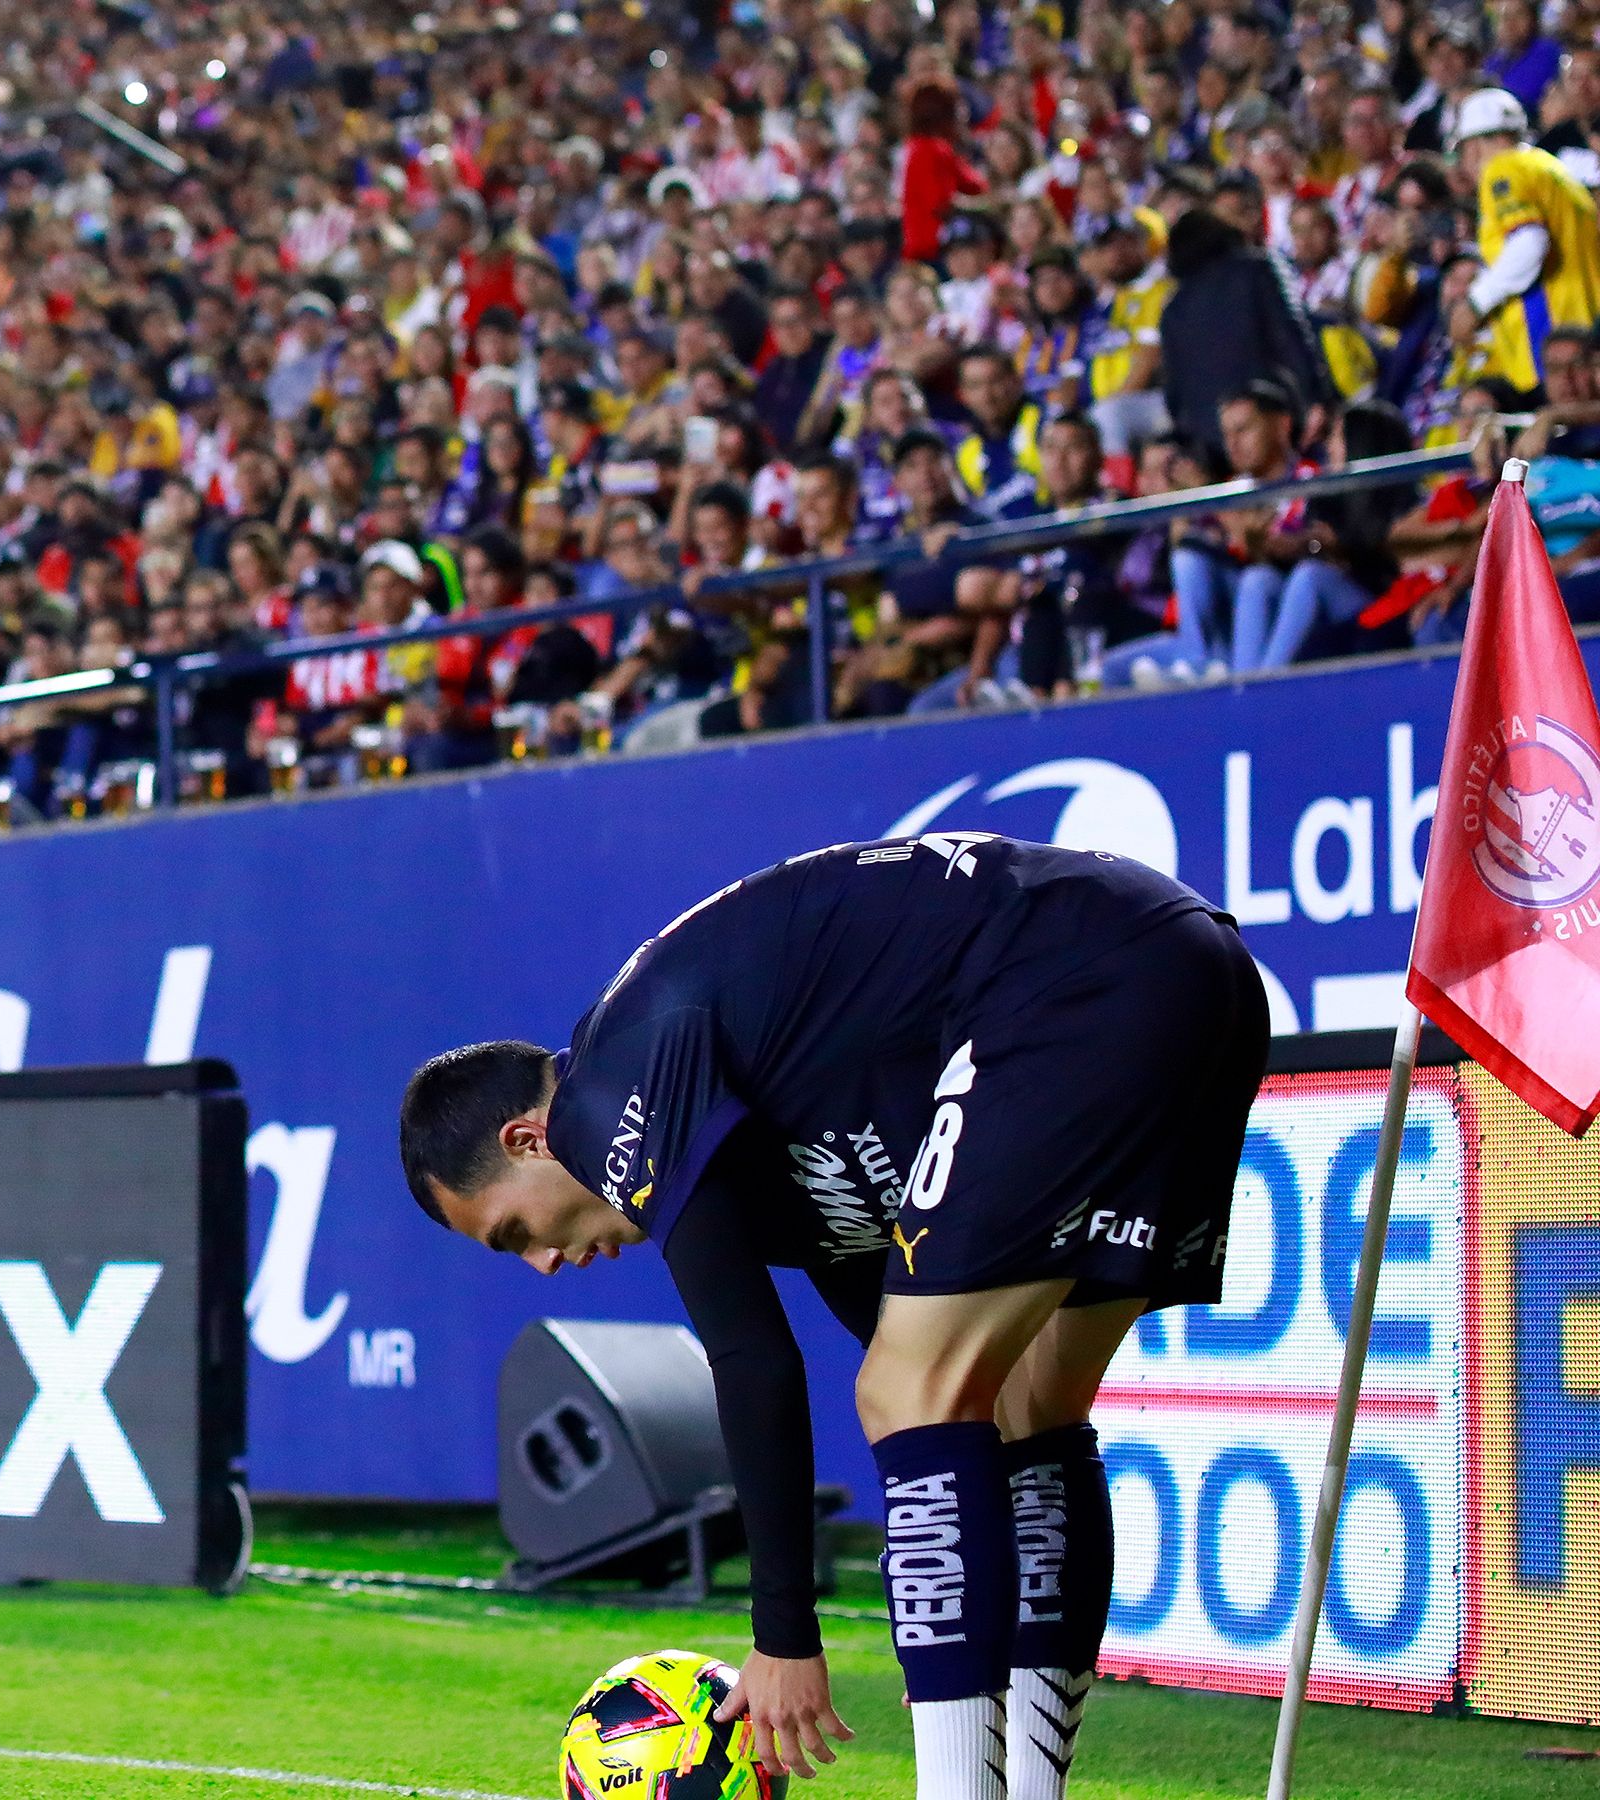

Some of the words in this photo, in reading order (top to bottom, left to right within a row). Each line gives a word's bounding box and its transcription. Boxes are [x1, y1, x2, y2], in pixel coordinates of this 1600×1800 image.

[605, 1093, 646, 1185] GNP
[348, 1327, 416, 1389] MR
[886, 1471, 967, 1647] PERDURA
[599, 1765, 645, 1793] Voit
